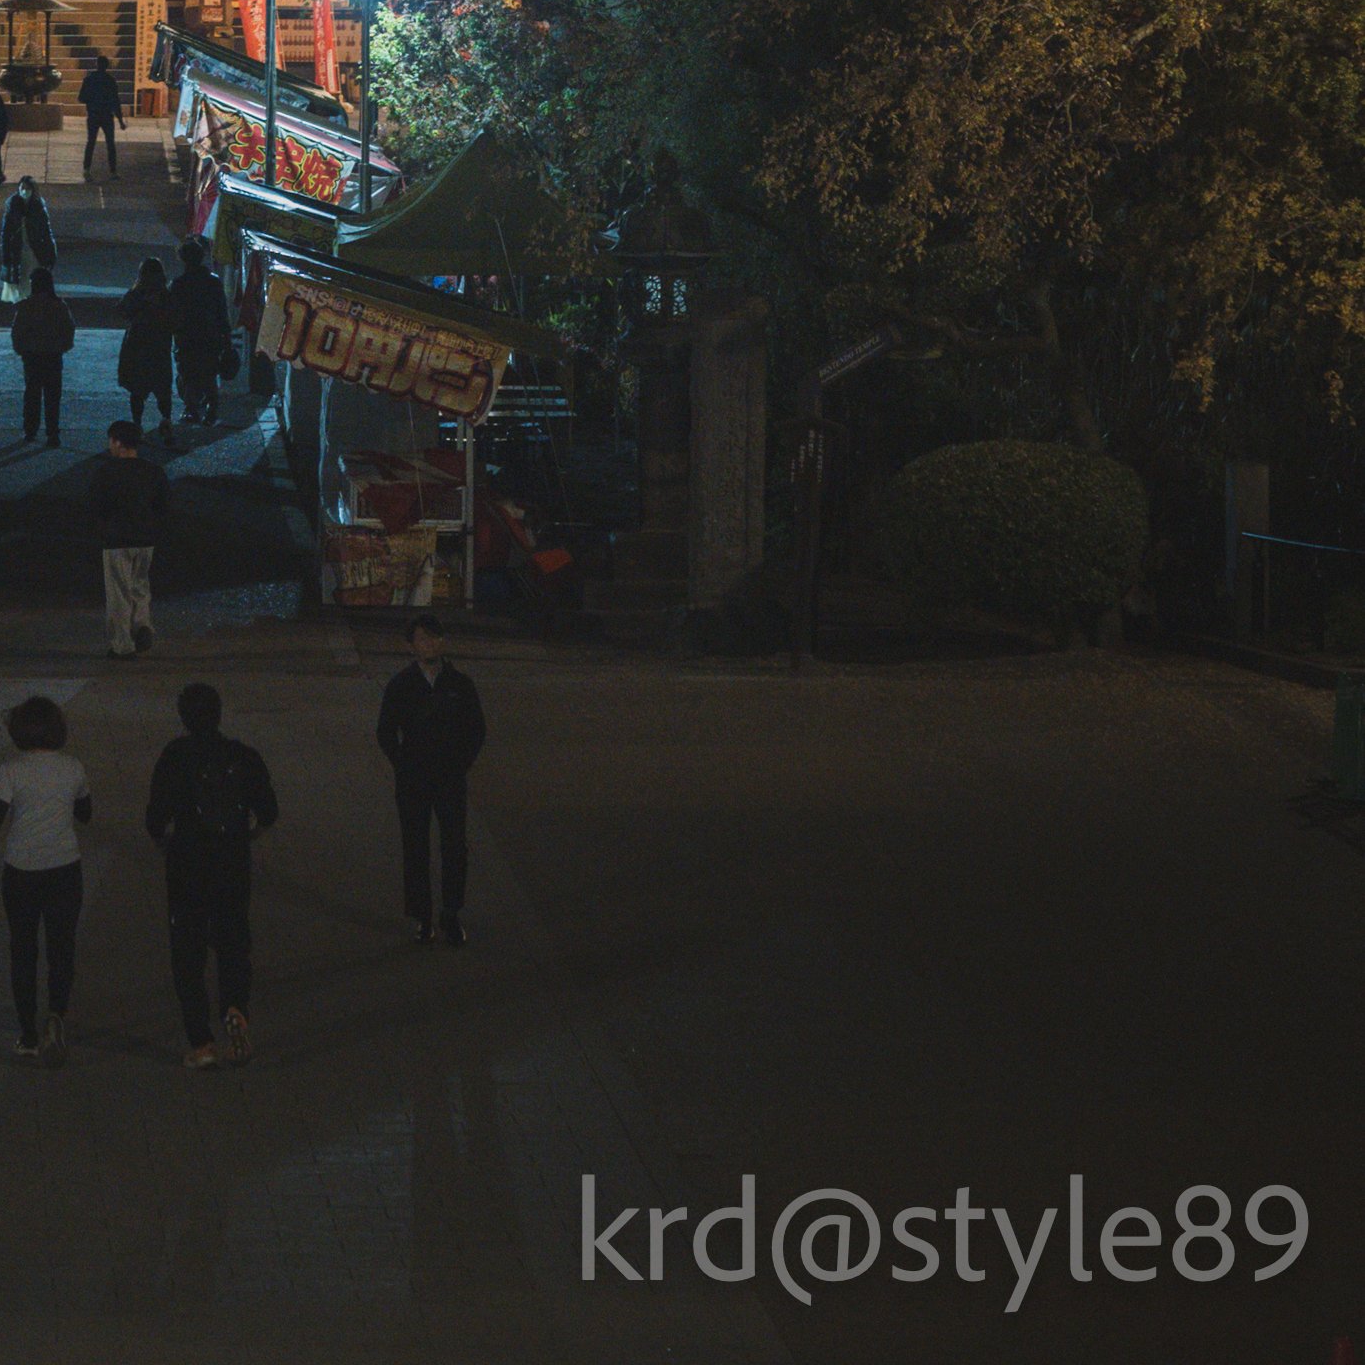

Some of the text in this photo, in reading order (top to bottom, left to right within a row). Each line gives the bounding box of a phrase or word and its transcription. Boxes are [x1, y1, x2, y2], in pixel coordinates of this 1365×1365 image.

[294, 285, 331, 309] SNS
[277, 294, 494, 418] 10円パン
